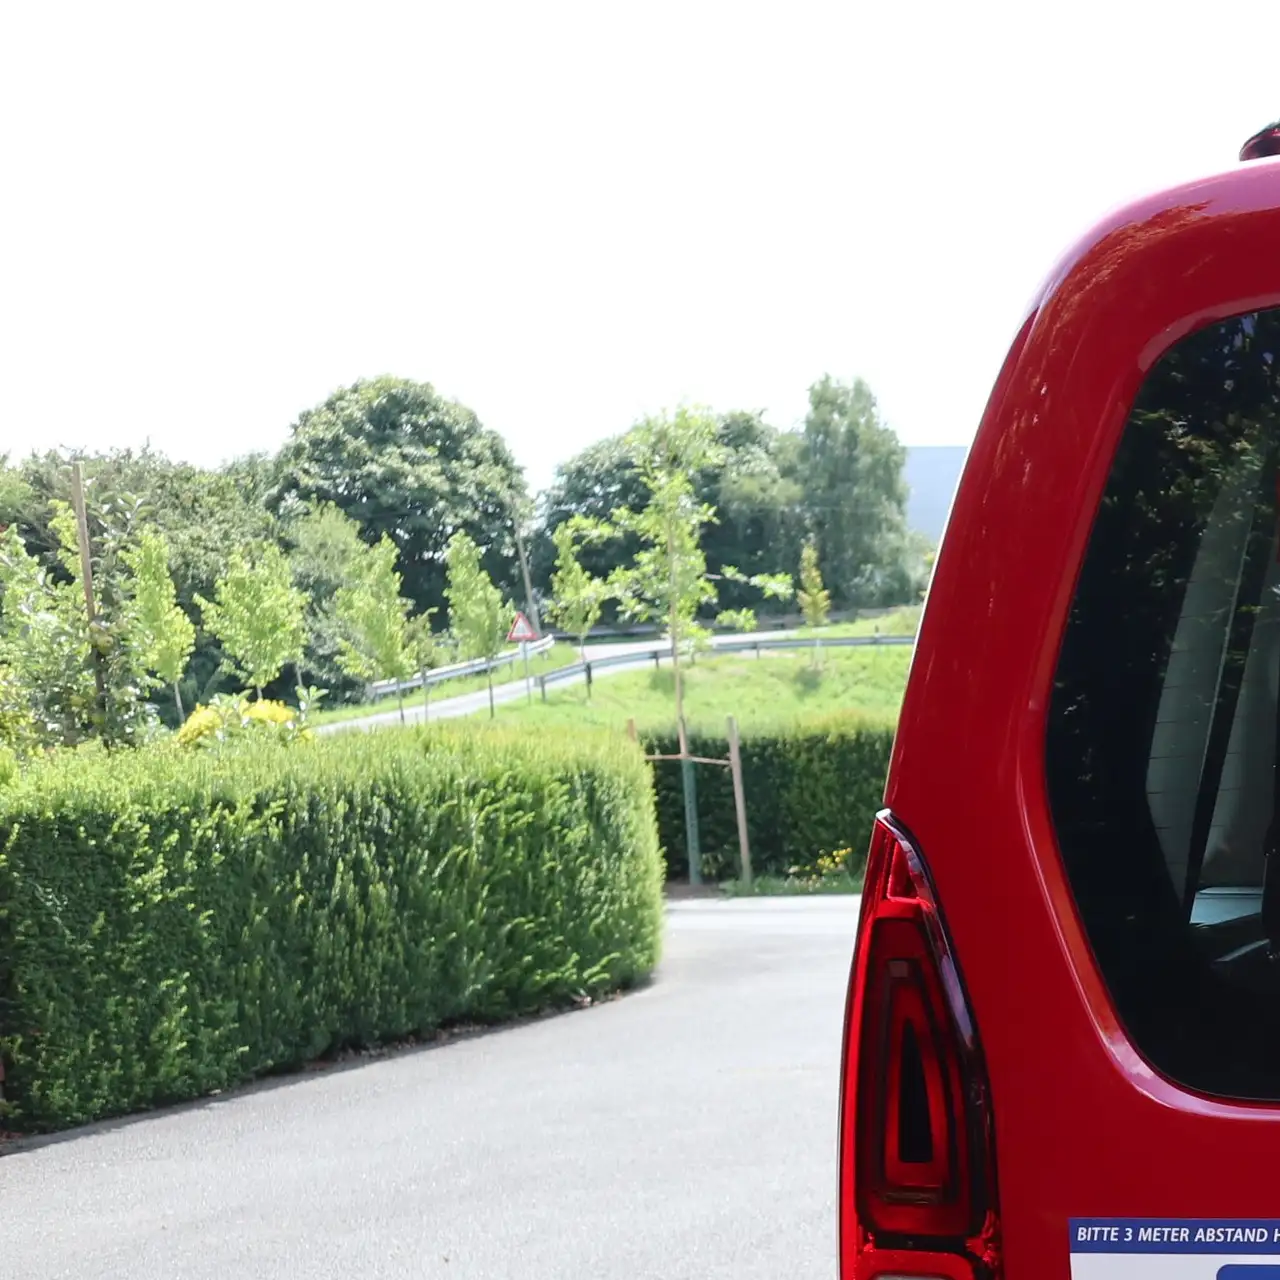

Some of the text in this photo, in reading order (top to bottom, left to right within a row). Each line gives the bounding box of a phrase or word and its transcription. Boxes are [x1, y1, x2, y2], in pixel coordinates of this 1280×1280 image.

[1077, 1227, 1119, 1242] BITTE
[1124, 1228, 1132, 1242] 3
[1138, 1227, 1190, 1243] METER
[1194, 1228, 1268, 1243] ABSTAND
